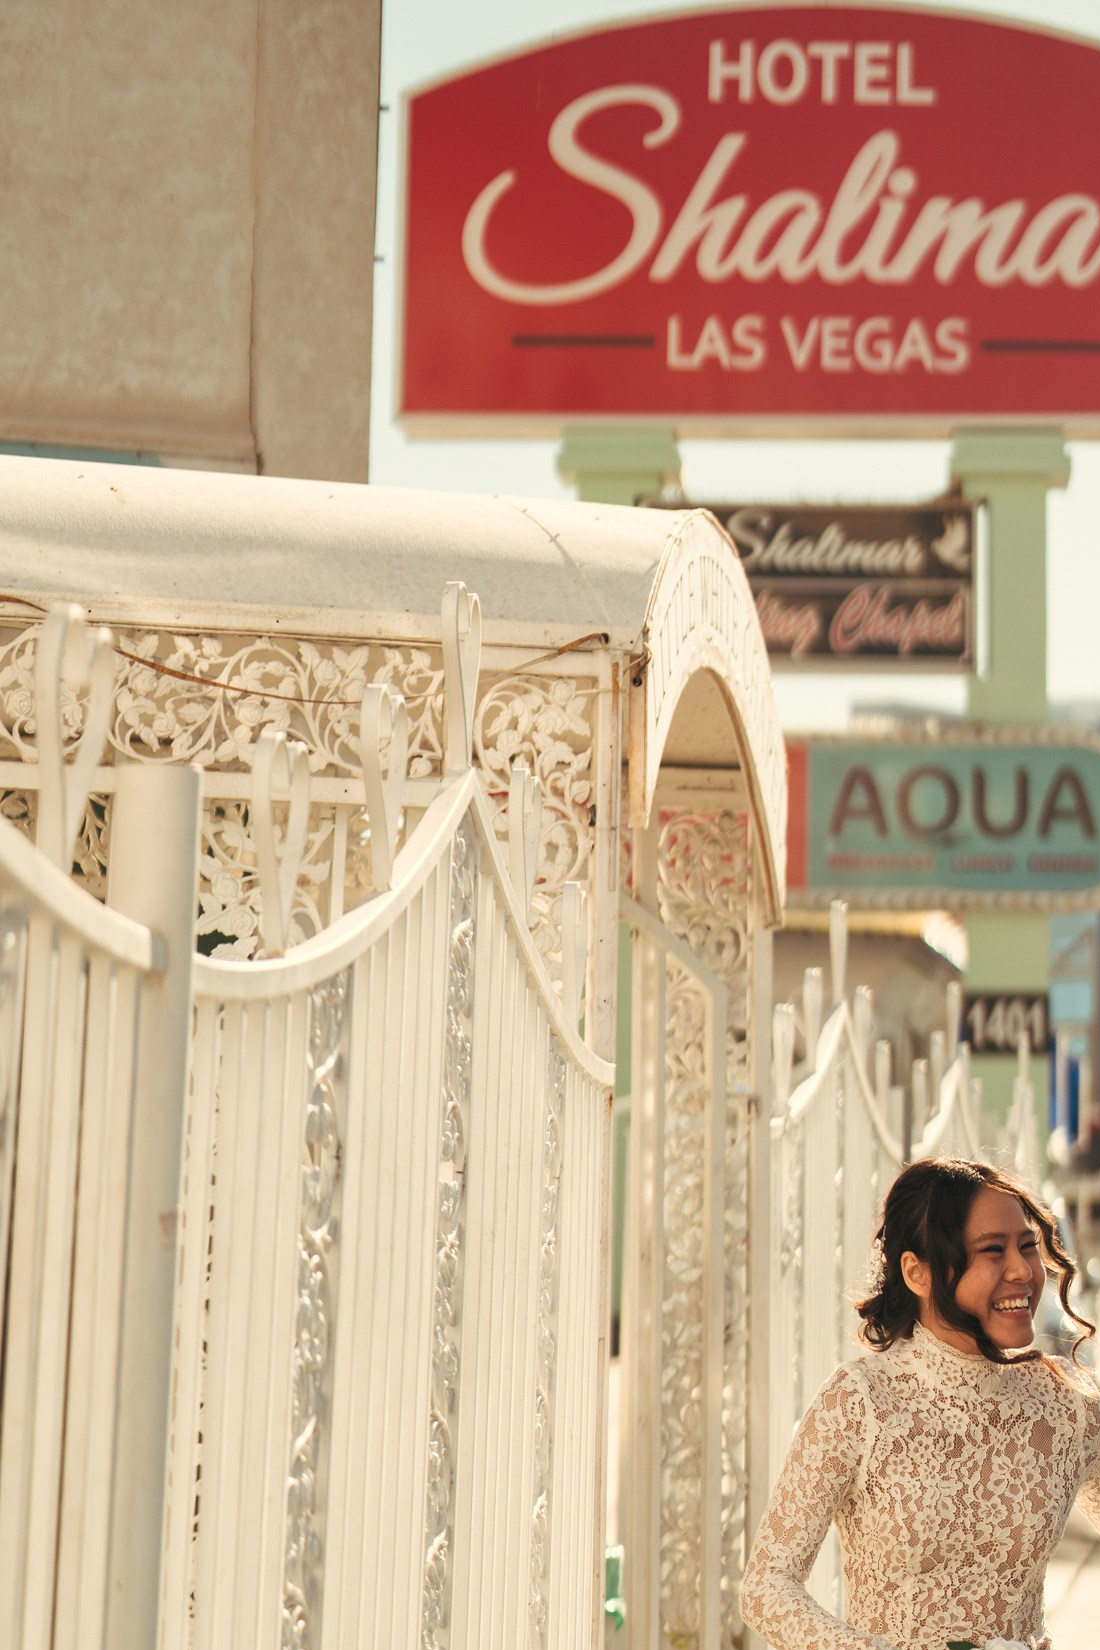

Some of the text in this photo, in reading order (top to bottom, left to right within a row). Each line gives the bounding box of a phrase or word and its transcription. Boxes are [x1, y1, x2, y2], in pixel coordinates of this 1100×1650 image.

[708, 39, 936, 105] HOTEL
[666, 315, 969, 374] LAS VEGAS
[727, 507, 925, 574] Shalimar
[651, 560, 695, 729] LITTLE
[699, 555, 738, 662] WHITE
[829, 584, 967, 657] Chapel
[828, 763, 1097, 849] AQUA
[966, 995, 1045, 1049] 1401
